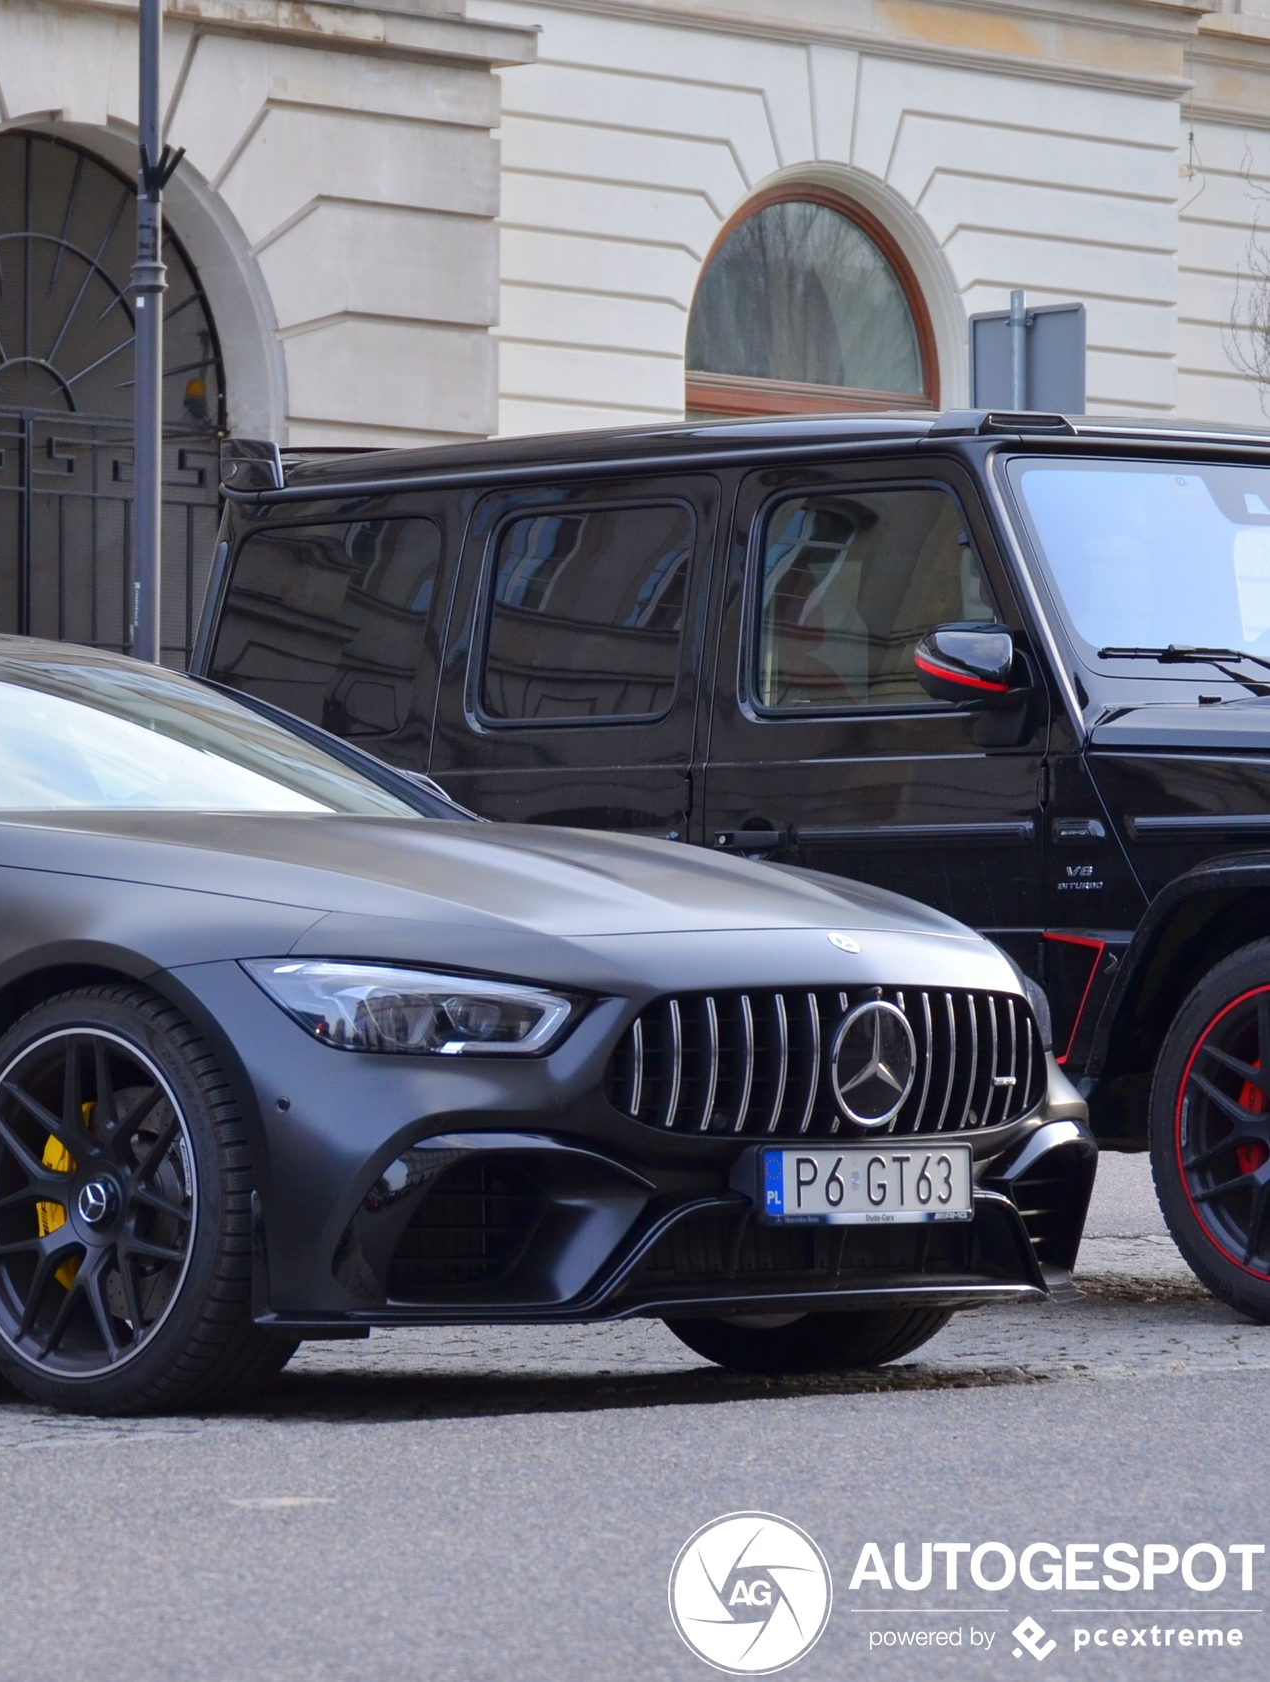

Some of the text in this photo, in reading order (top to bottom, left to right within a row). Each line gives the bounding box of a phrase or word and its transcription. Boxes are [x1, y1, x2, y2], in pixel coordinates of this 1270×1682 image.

[1066, 866, 1093, 877] V8
[1057, 881, 1104, 890] BITURBO
[796, 1153, 953, 1208] P6 GT63
[767, 1190, 782, 1205] PL
[865, 1213, 895, 1222] Duda-Cars
[944, 1212, 968, 1220] AMG
